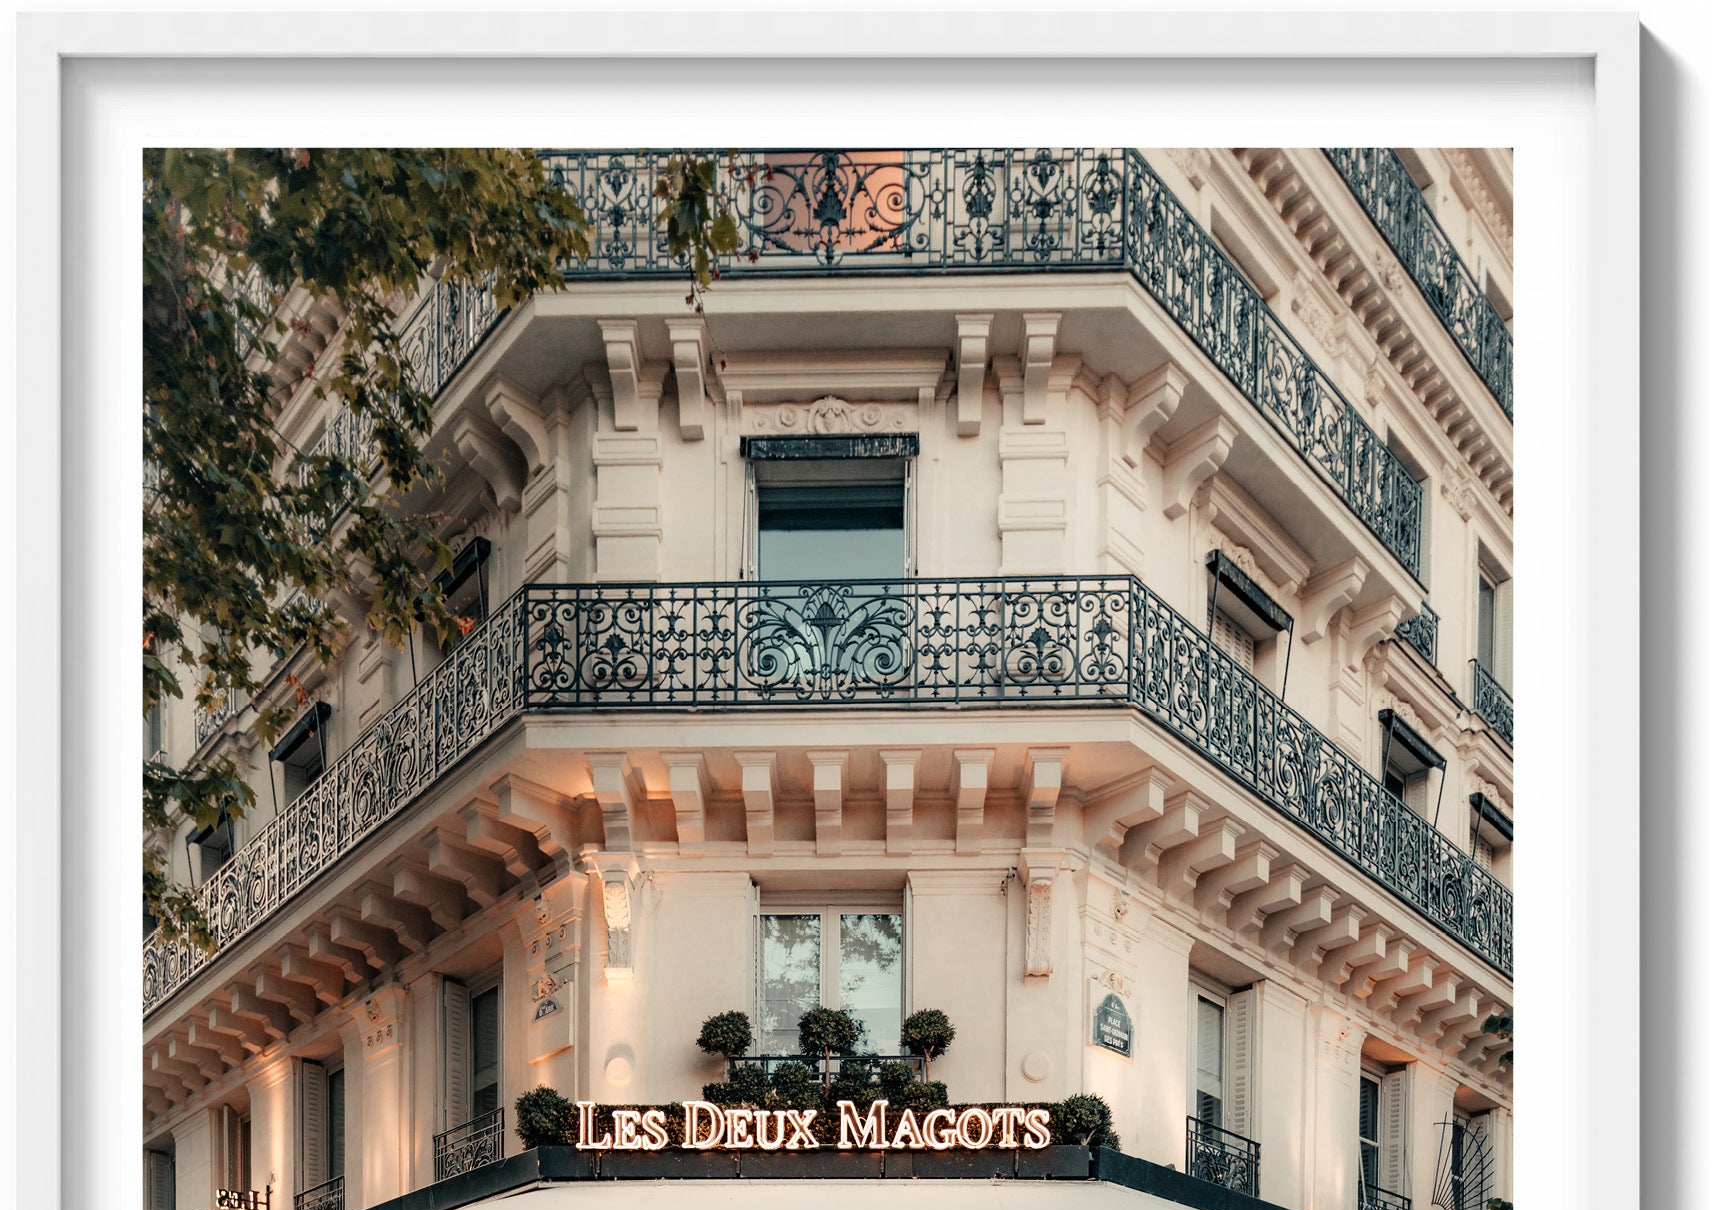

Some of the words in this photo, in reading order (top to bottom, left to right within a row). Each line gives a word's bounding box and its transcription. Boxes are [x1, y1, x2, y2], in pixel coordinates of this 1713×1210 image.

[575, 1100, 669, 1151] LES
[681, 1099, 821, 1151] DEUX
[836, 1099, 1052, 1151] MAGOTS
